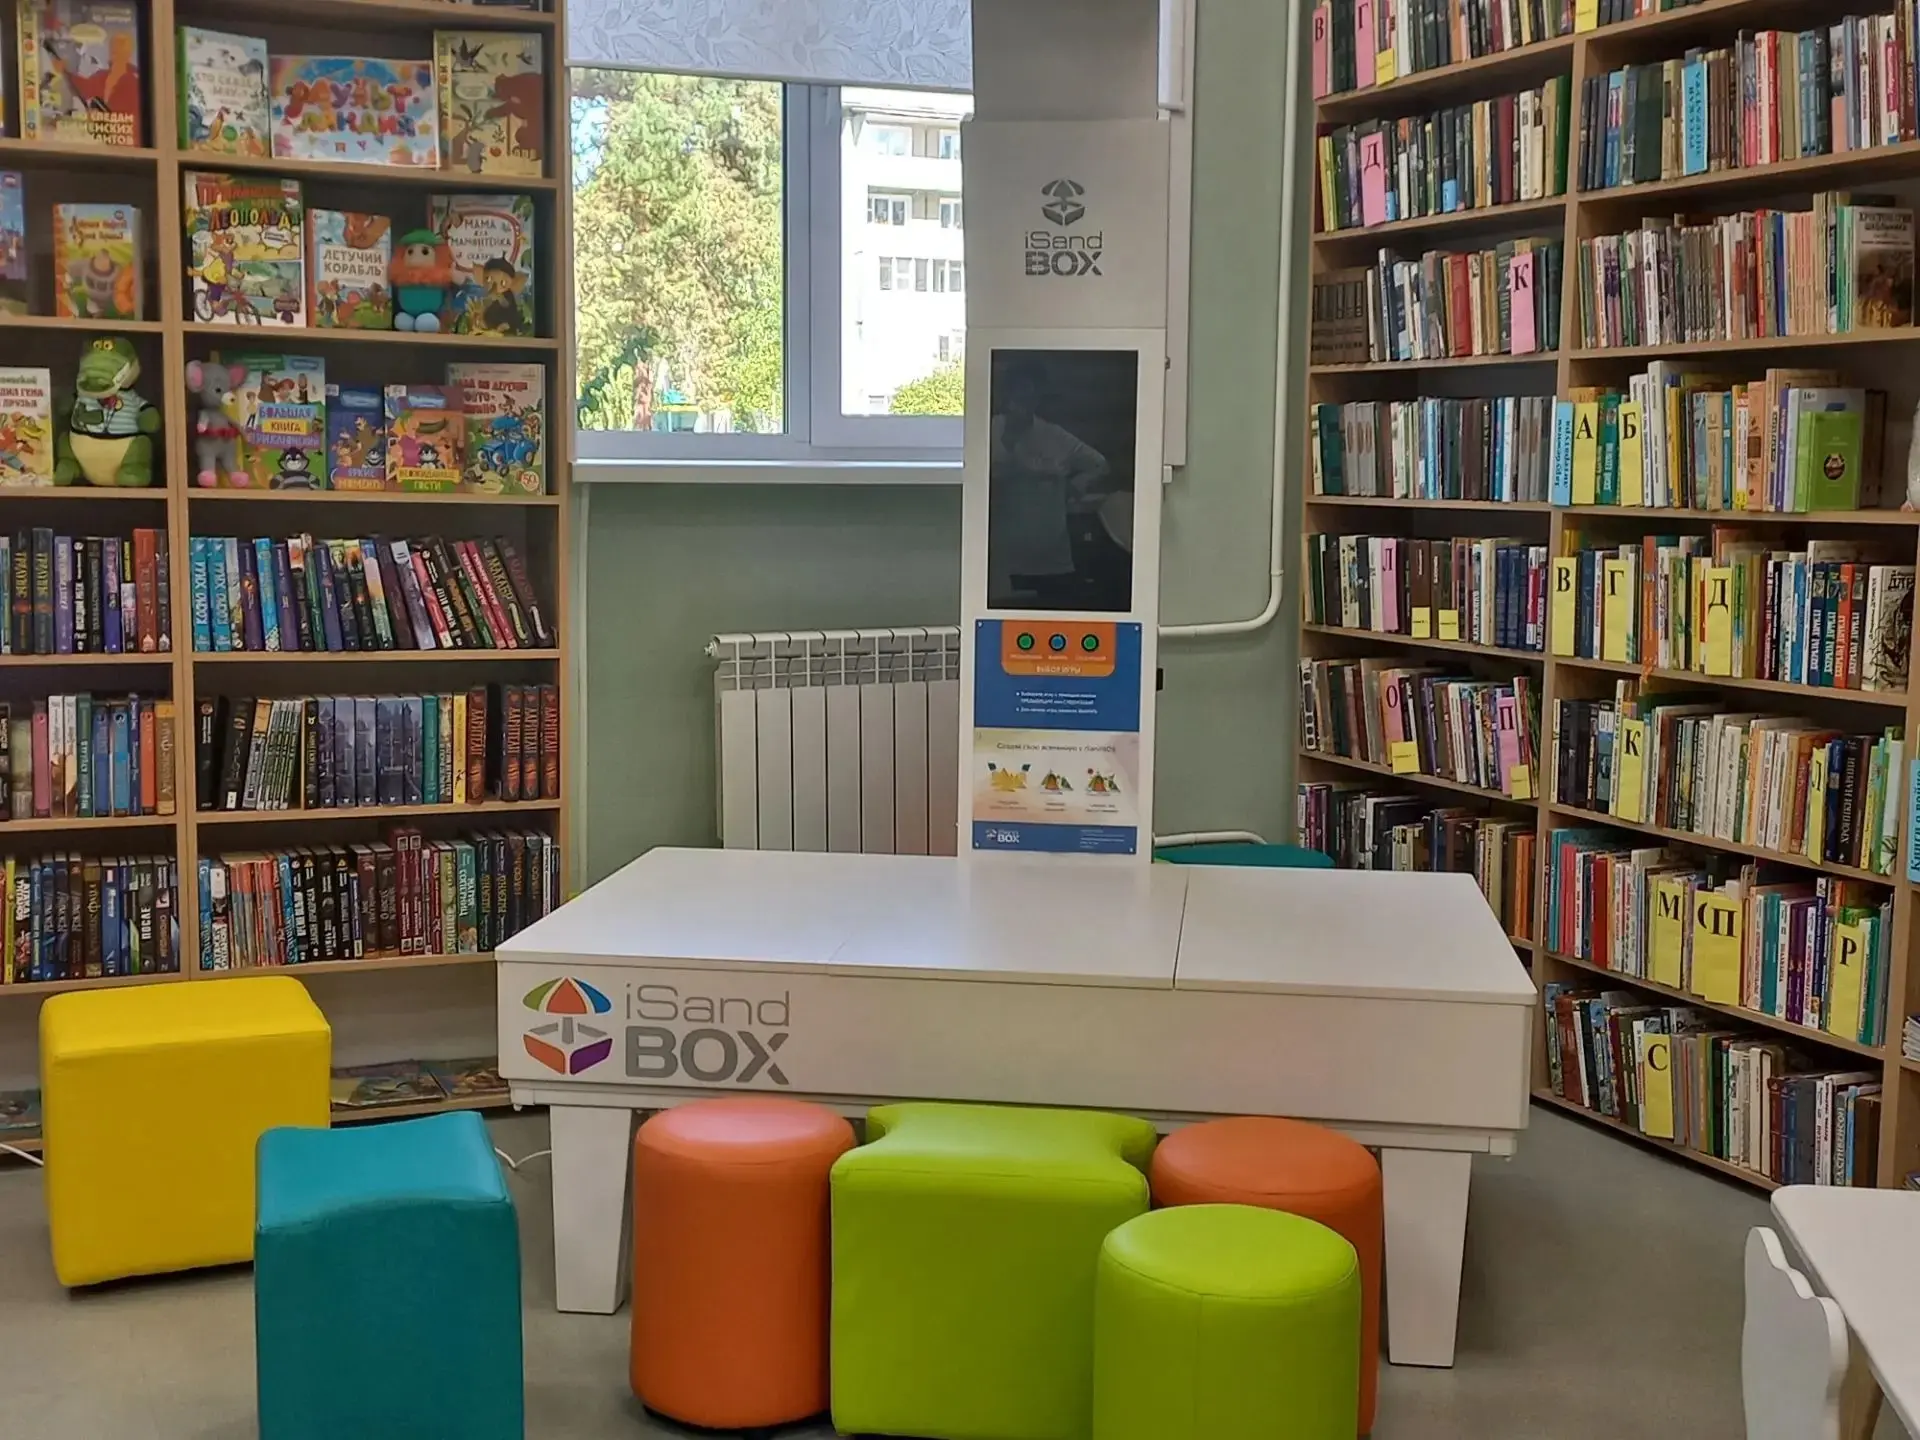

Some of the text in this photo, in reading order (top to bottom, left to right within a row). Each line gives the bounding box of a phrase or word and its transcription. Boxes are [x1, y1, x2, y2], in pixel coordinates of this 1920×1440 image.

[1315, 16, 1325, 42] В
[1357, 2, 1369, 29] Г
[1363, 142, 1381, 171] Д
[1025, 231, 1103, 249] iSand
[323, 249, 383, 265] ЛЕТУЧИЙ
[323, 263, 383, 277] КОРАБЛЬ
[1025, 251, 1102, 276] BOX
[1513, 263, 1530, 293] К
[259, 405, 314, 419] БОЛЬШАЯ
[1622, 411, 1637, 440] Б
[270, 420, 302, 433] КНИГА
[1576, 413, 1595, 440] А
[1382, 547, 1394, 571] Л
[1556, 566, 1571, 592] В
[1608, 569, 1625, 596] Г
[1708, 577, 1730, 613] Д
[1499, 706, 1514, 731] П
[1625, 728, 1640, 757] К
[1811, 758, 1823, 792] Л
[997, 834, 1020, 843] BOX
[1658, 890, 1680, 922] М
[1711, 908, 1737, 938] П
[1840, 936, 1857, 967] Р
[625, 983, 789, 1026] iSand
[625, 1026, 789, 1085] BOX
[1648, 1043, 1668, 1071] С
